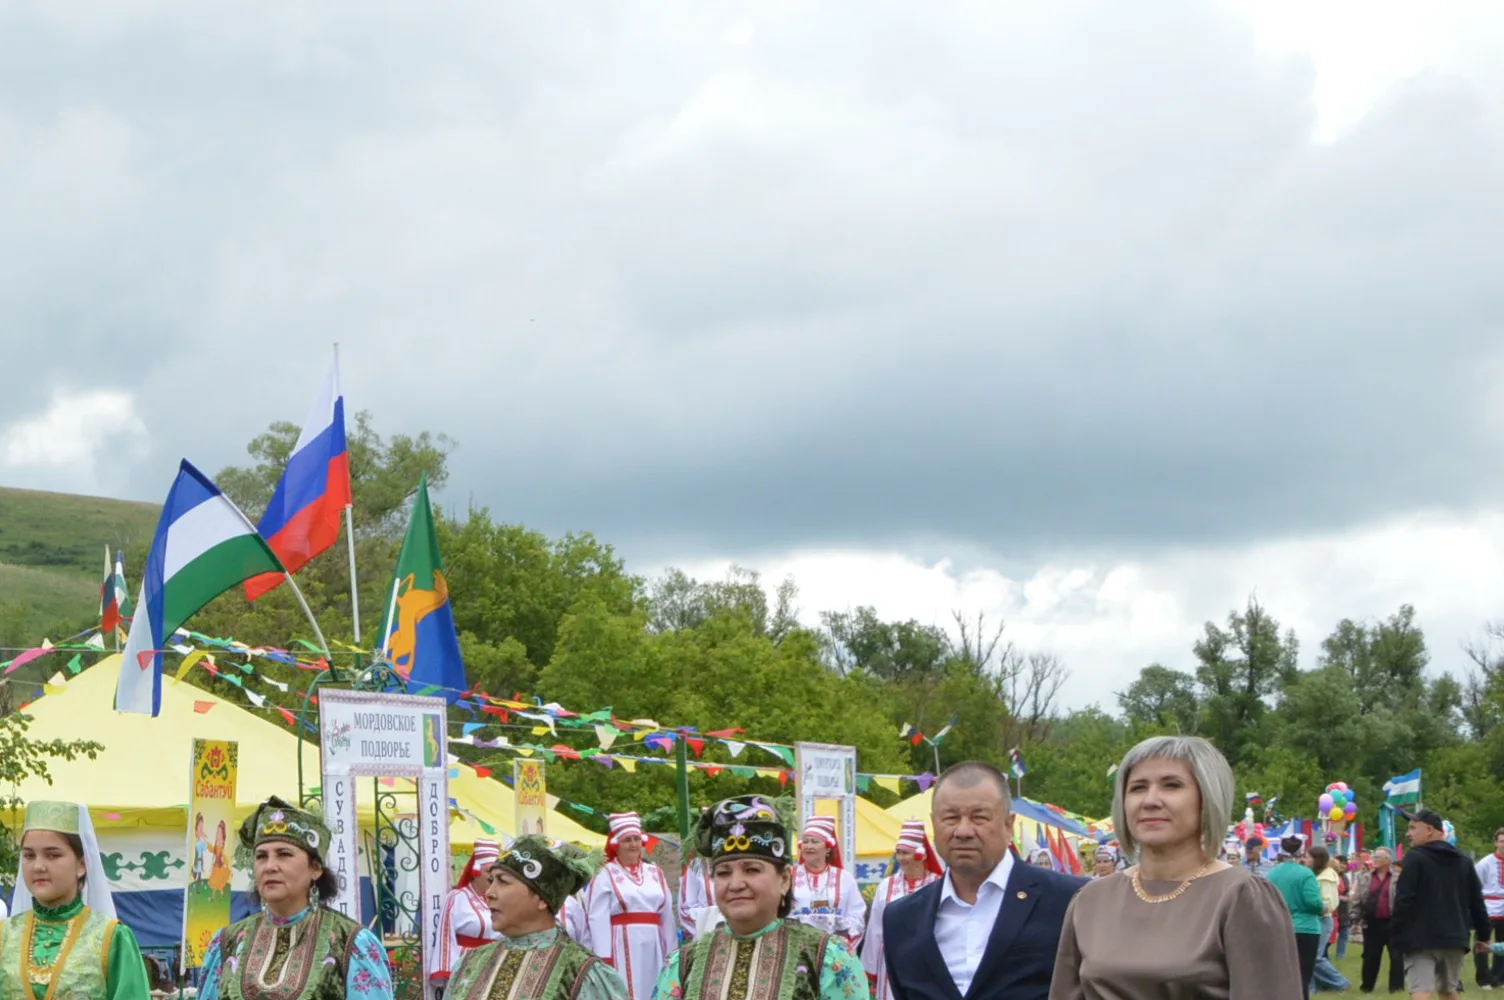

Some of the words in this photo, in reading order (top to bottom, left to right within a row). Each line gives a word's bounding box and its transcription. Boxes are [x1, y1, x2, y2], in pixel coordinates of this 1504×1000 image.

[353, 712, 416, 732] МОРДОВСКОЕ
[360, 740, 411, 760] ПОДВОРЬЕ
[195, 778, 233, 801] Сабантуй
[428, 783, 440, 873] ДОБРО
